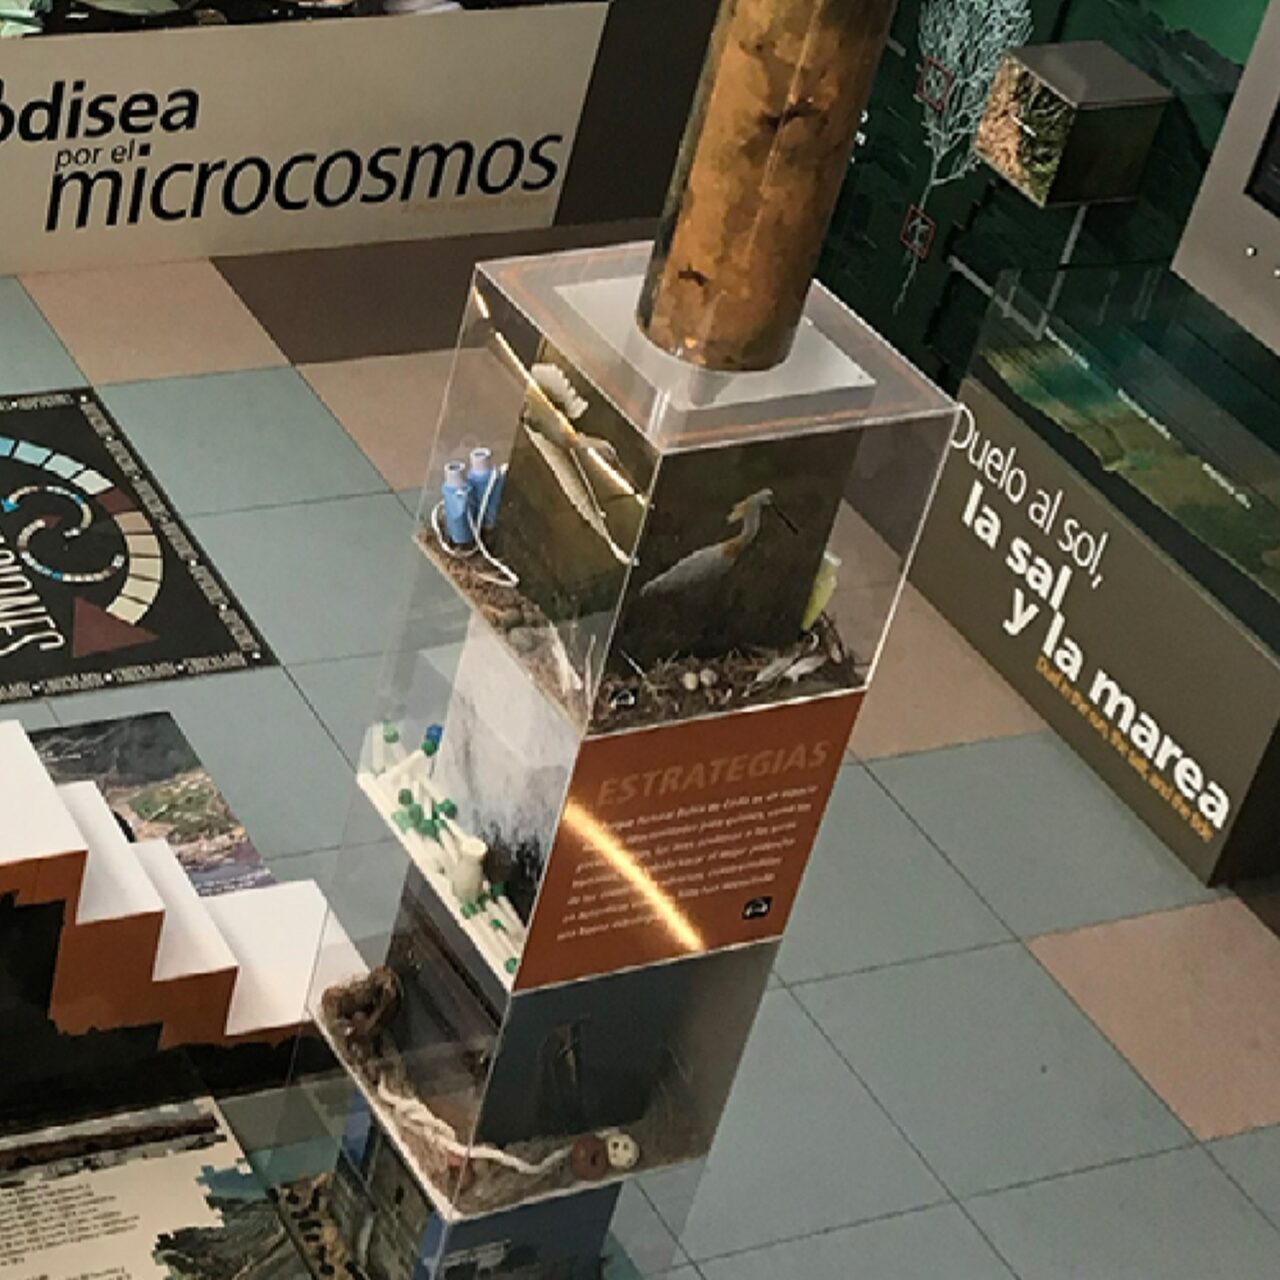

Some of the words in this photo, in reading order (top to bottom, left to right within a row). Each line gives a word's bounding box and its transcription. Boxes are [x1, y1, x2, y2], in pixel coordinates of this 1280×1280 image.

[44, 133, 564, 233] microcosmos
[54, 144, 104, 174] por
[111, 140, 135, 164] el
[950, 403, 1027, 504] Duelo
[1028, 489, 1064, 535] al
[1057, 518, 1109, 589] sol,
[961, 480, 1001, 549] la
[1005, 537, 1072, 611] sal
[1002, 588, 1039, 635] y
[1042, 611, 1084, 683] la
[1089, 669, 1231, 830] marea
[596, 740, 831, 808] ESTRATEGIAS
